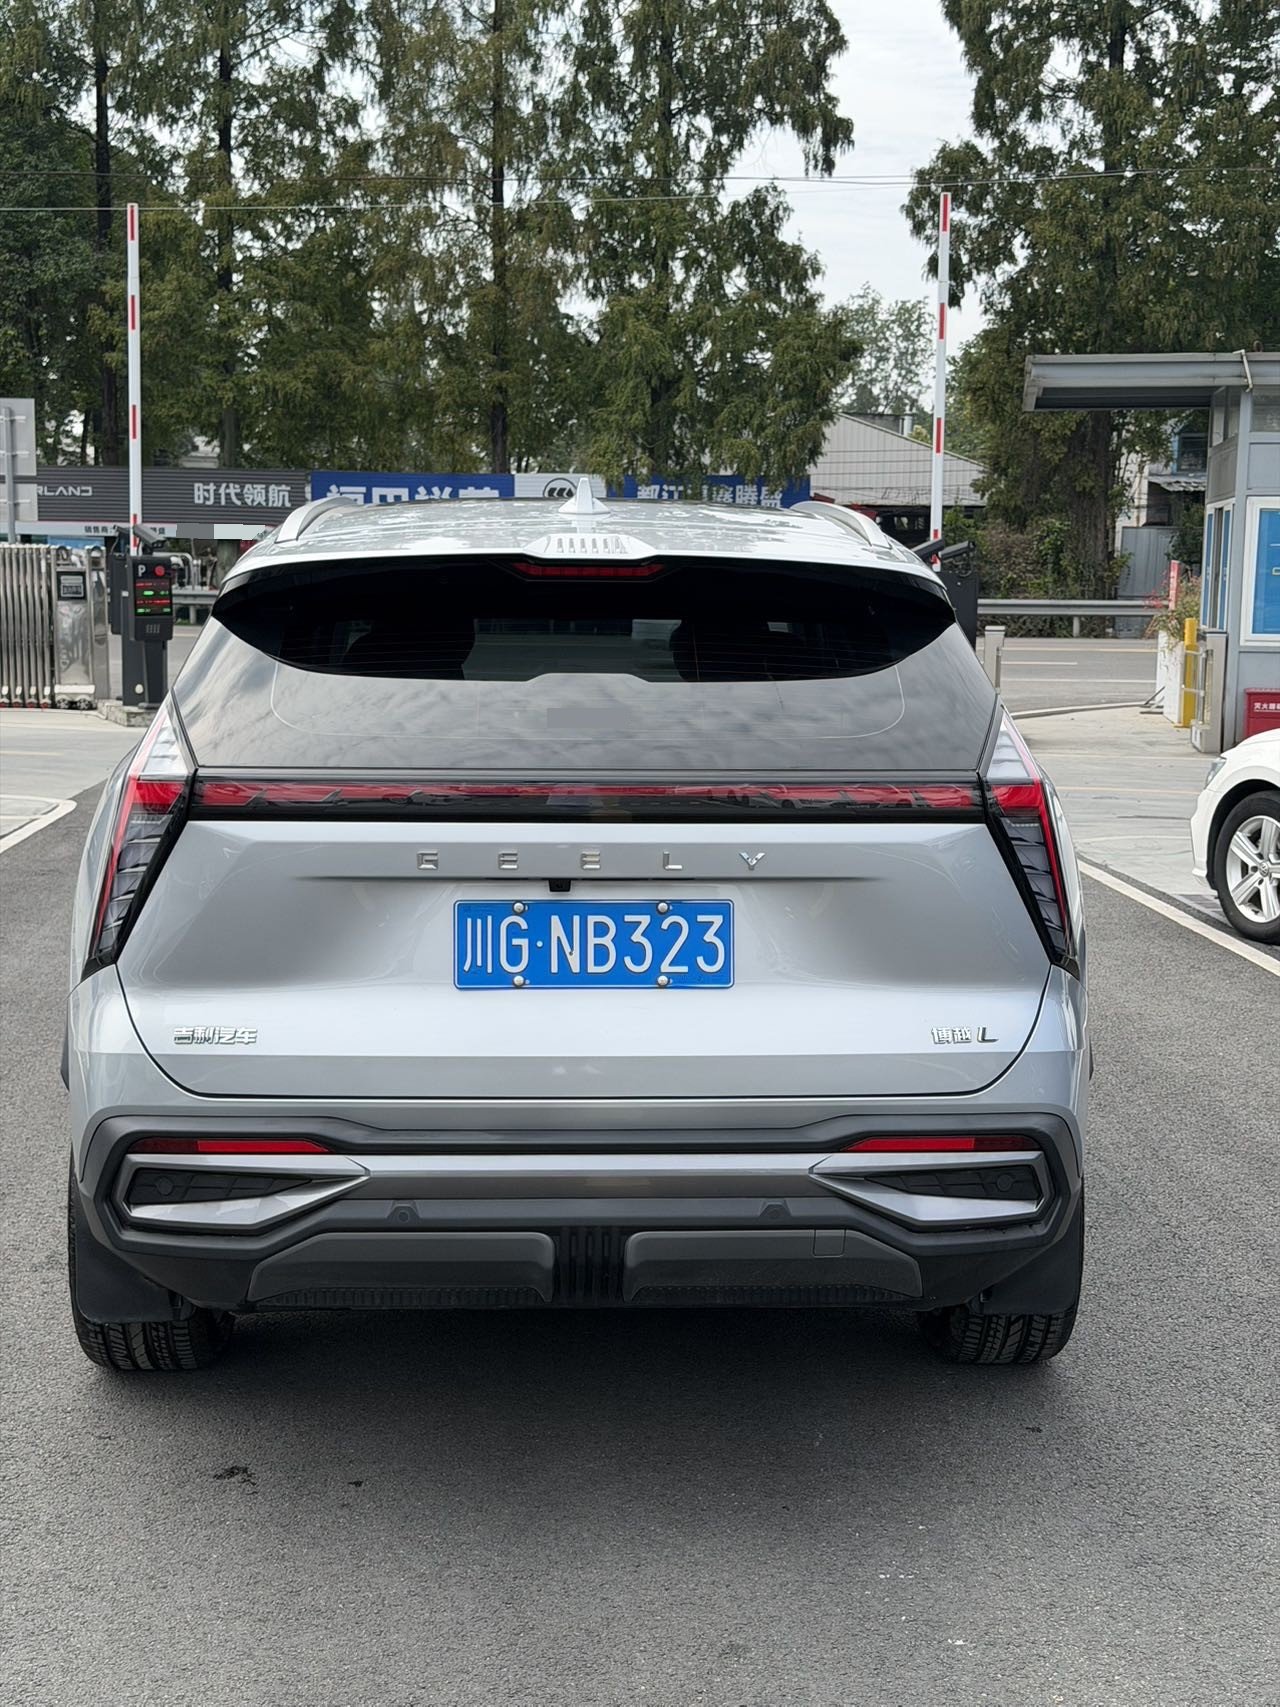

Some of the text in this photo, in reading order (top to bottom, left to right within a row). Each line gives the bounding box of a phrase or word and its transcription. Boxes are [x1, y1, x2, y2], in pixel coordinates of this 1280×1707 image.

[194, 482, 292, 507] 时代领航
[138, 564, 146, 577] P
[417, 851, 766, 871] GEELY
[463, 914, 725, 974] 川G·NB323
[174, 1026, 258, 1045] 吉利汽车
[976, 1026, 999, 1044] L
